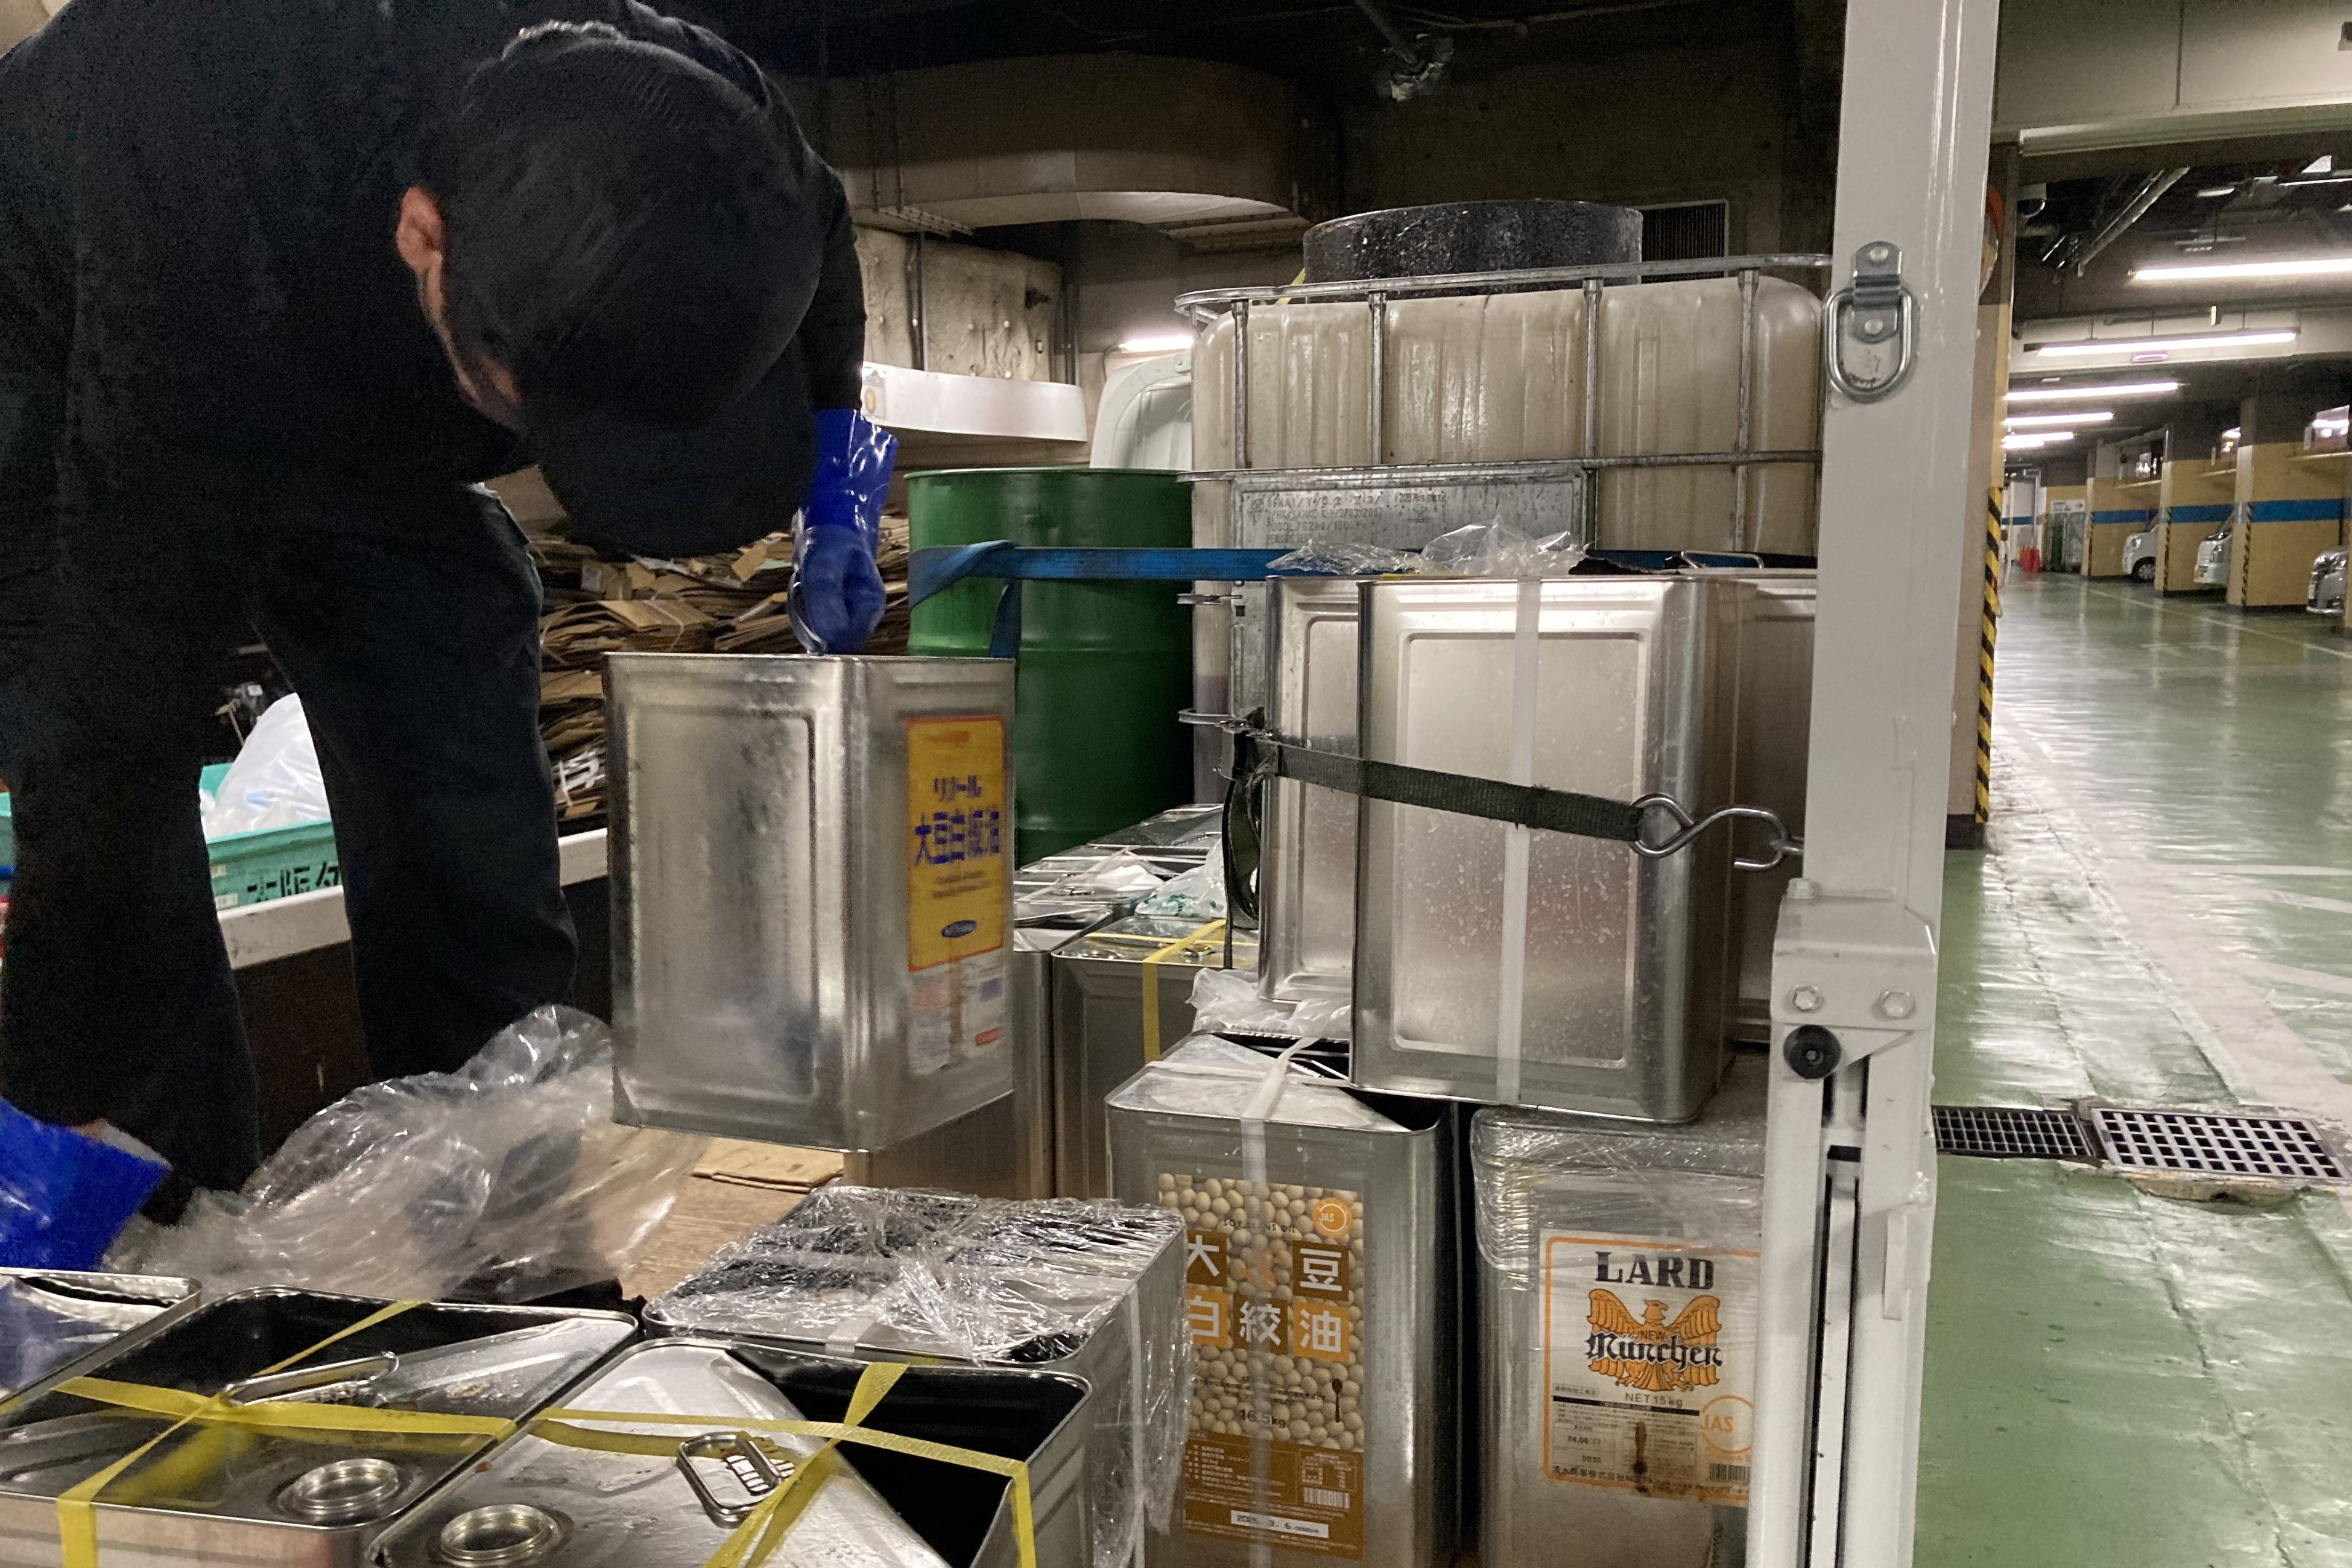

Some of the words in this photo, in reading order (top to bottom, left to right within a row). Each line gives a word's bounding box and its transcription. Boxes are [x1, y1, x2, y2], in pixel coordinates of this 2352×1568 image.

[1319, 1213, 1335, 1222] JAS
[1224, 1218, 1242, 1227] SOY
[1282, 1225, 1297, 1234] OIL
[1595, 1251, 1714, 1290] LARD
[1640, 1330, 1666, 1341] NEW
[1625, 1393, 1651, 1404] NET
[1699, 1414, 1734, 1434] JAS
